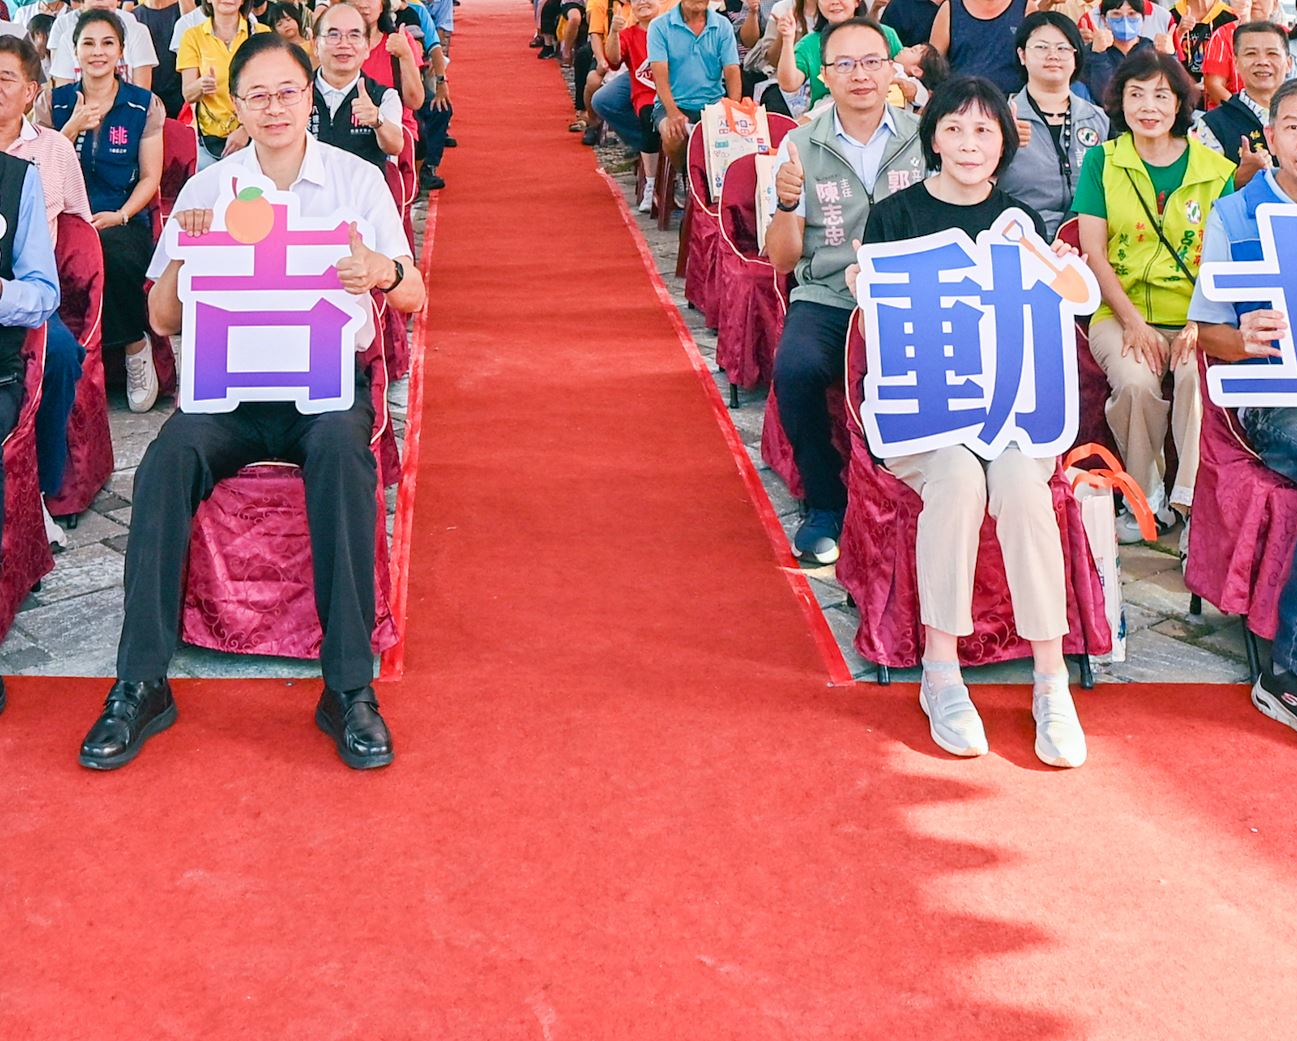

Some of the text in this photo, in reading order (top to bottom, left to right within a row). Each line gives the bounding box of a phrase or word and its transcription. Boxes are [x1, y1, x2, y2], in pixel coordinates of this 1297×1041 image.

[815, 181, 845, 246] 陳志忠
[840, 178, 852, 198] 主任
[178, 203, 362, 401] 吉
[869, 242, 1064, 446] 動
